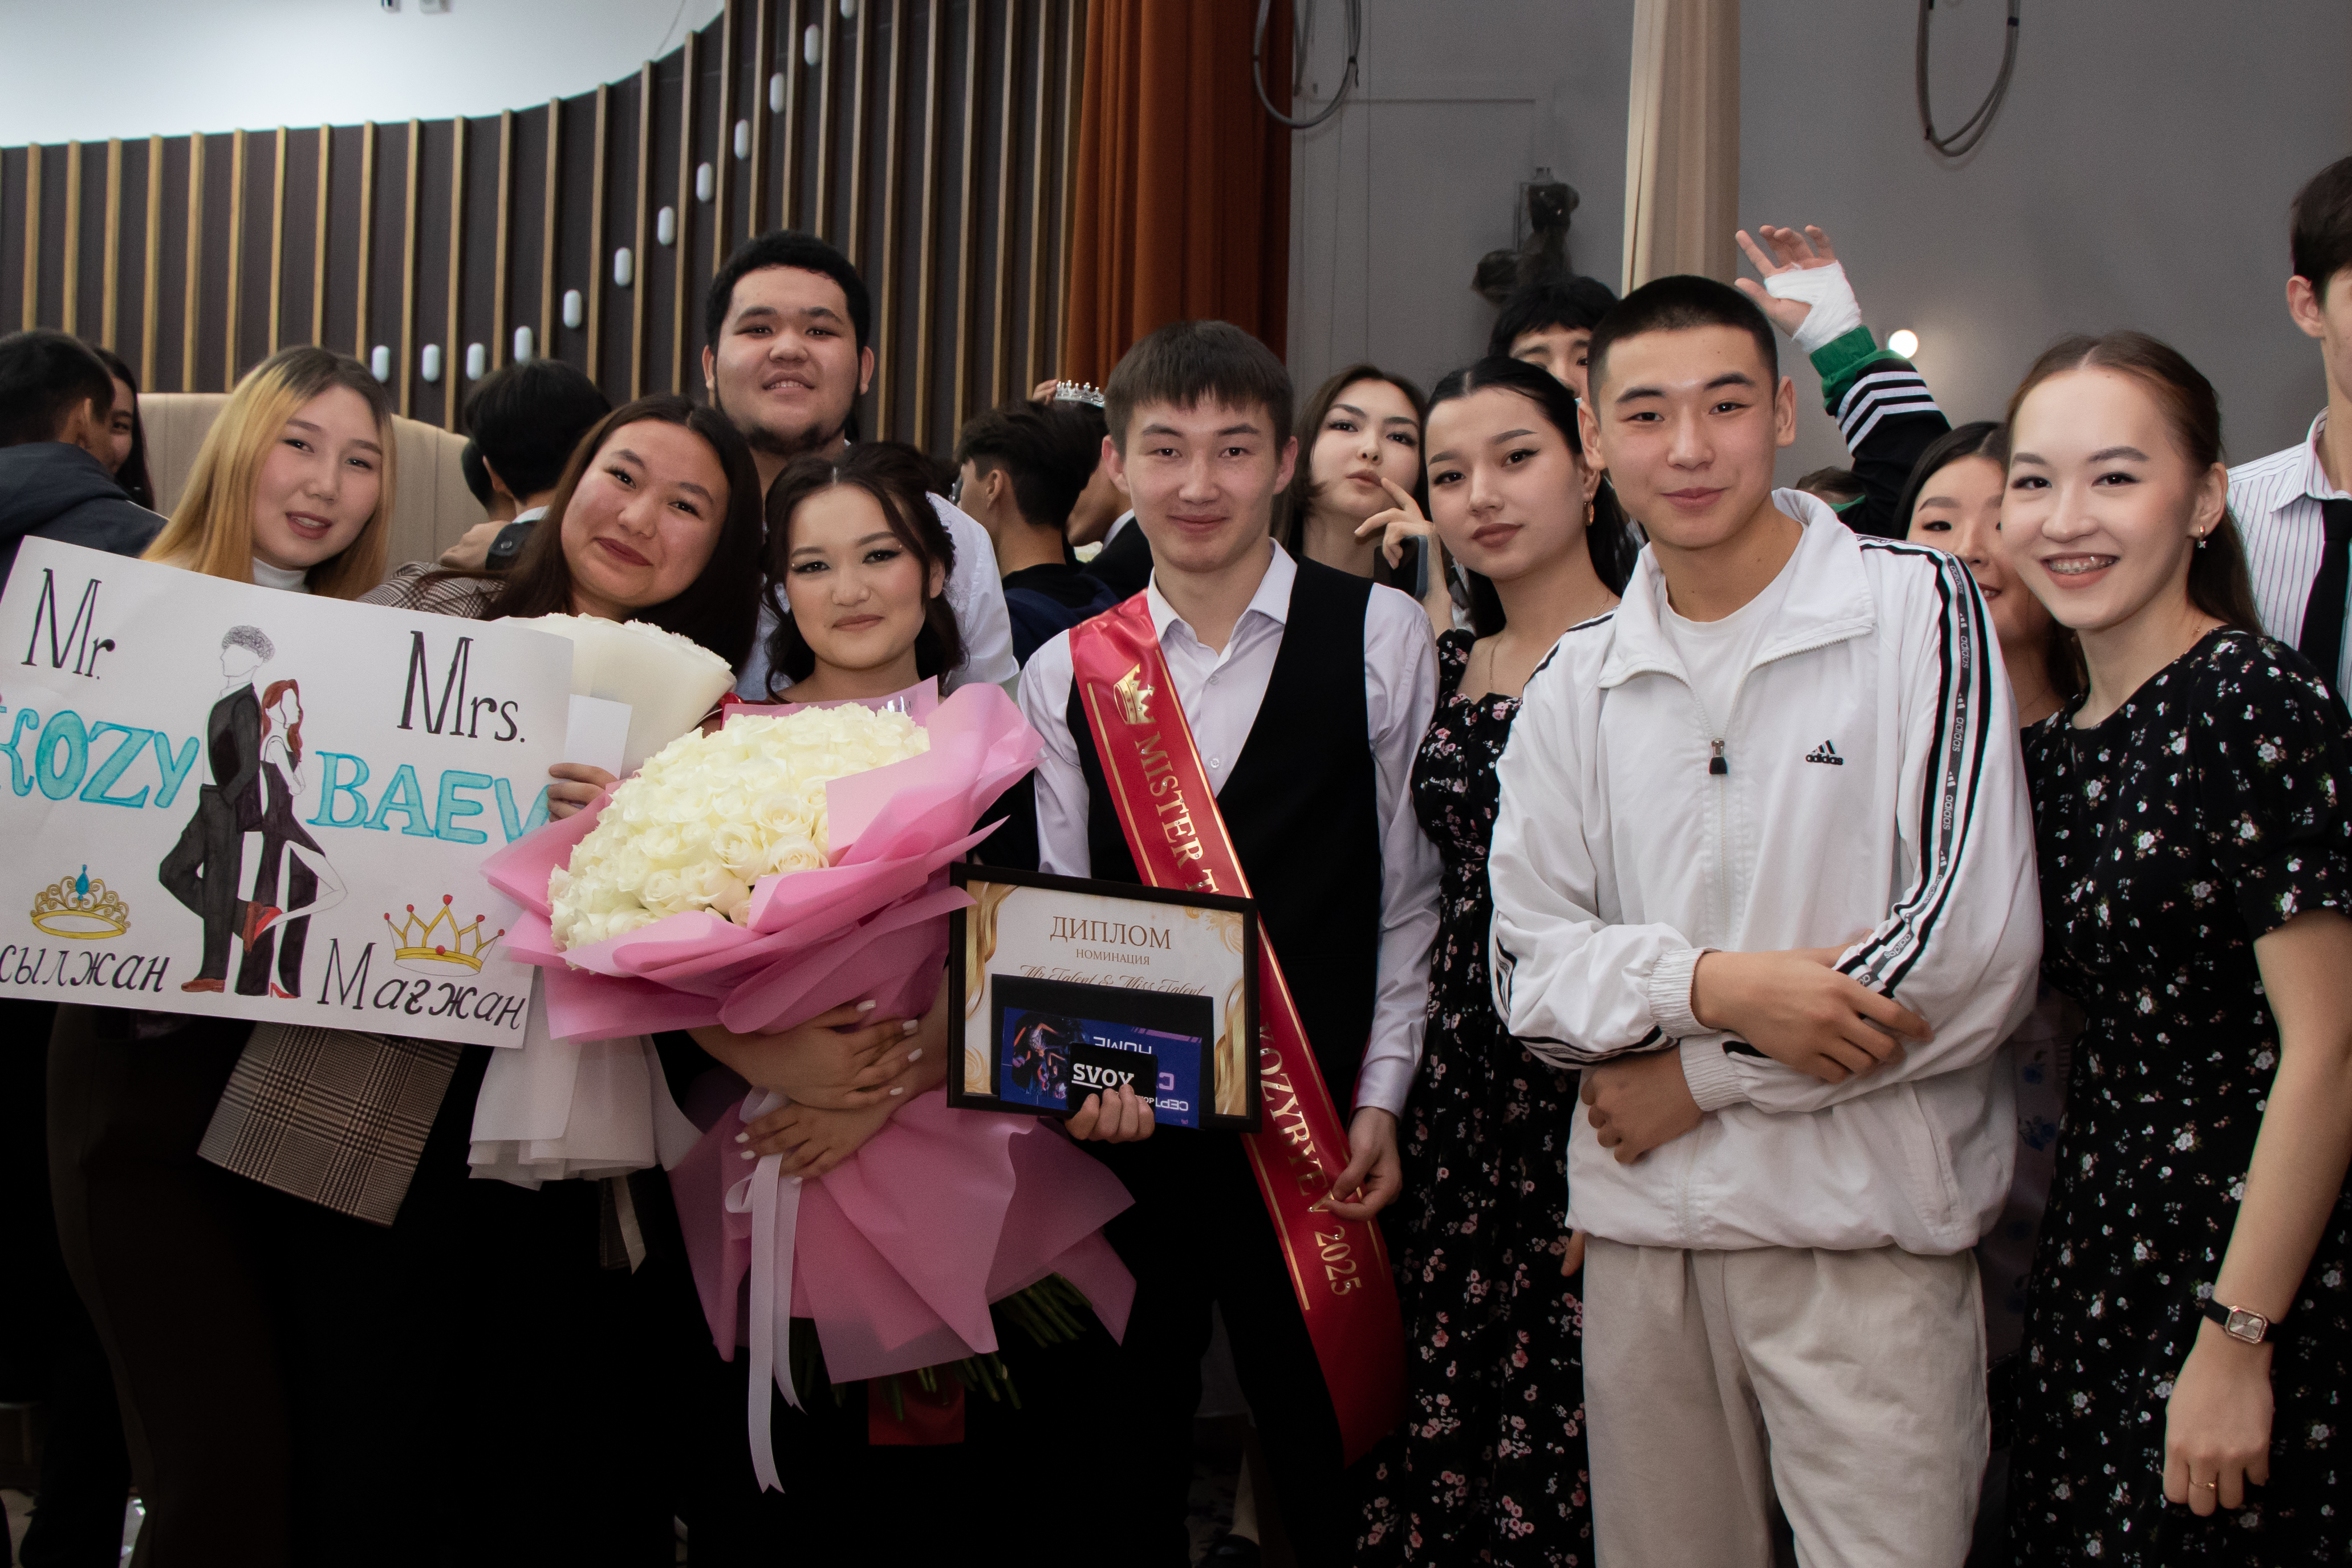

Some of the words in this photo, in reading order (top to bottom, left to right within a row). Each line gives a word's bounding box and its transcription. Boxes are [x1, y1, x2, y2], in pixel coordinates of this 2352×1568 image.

[1949, 564, 1965, 594] adidas
[21, 567, 116, 680] Mr.
[1960, 635, 1969, 669] adidas
[396, 629, 525, 743] Mrs.
[1952, 717, 1964, 752] adidas
[1805, 753, 1844, 766] adidas
[306, 750, 551, 845] BAEV
[1135, 730, 1204, 870] MISTER
[1943, 794, 1953, 830] adidas
[1050, 916, 1172, 950] ДИПЛОМ
[1884, 933, 1911, 959] adidas
[1076, 948, 1150, 965] НОМИНАЦИЯ
[317, 938, 527, 1030] Магжан
[1073, 1063, 1134, 1087] SVOY
[1314, 1225, 1362, 1296] 2025
